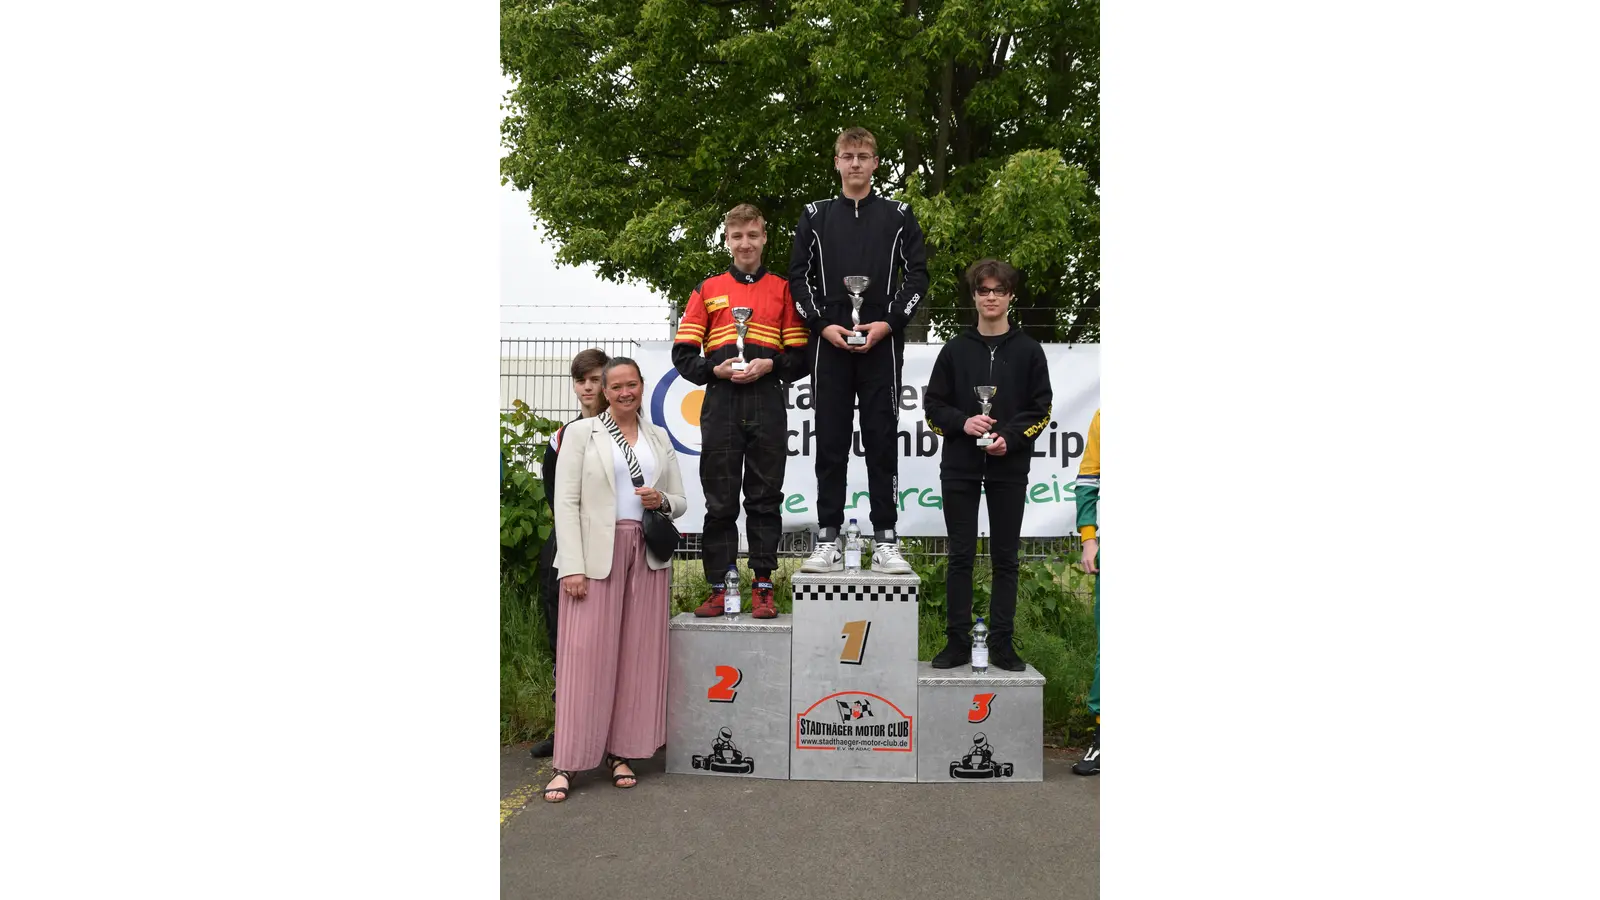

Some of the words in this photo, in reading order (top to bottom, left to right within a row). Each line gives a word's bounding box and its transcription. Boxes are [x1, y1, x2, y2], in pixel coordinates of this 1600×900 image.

[840, 619, 871, 665] 1
[707, 665, 742, 703] 2
[968, 692, 997, 724] 3
[800, 718, 853, 737] STADTHÄGER
[855, 724, 885, 737] MOTOR
[888, 720, 909, 738] CLUB
[801, 737, 908, 747] www.stadthaeger-motor-club.de
